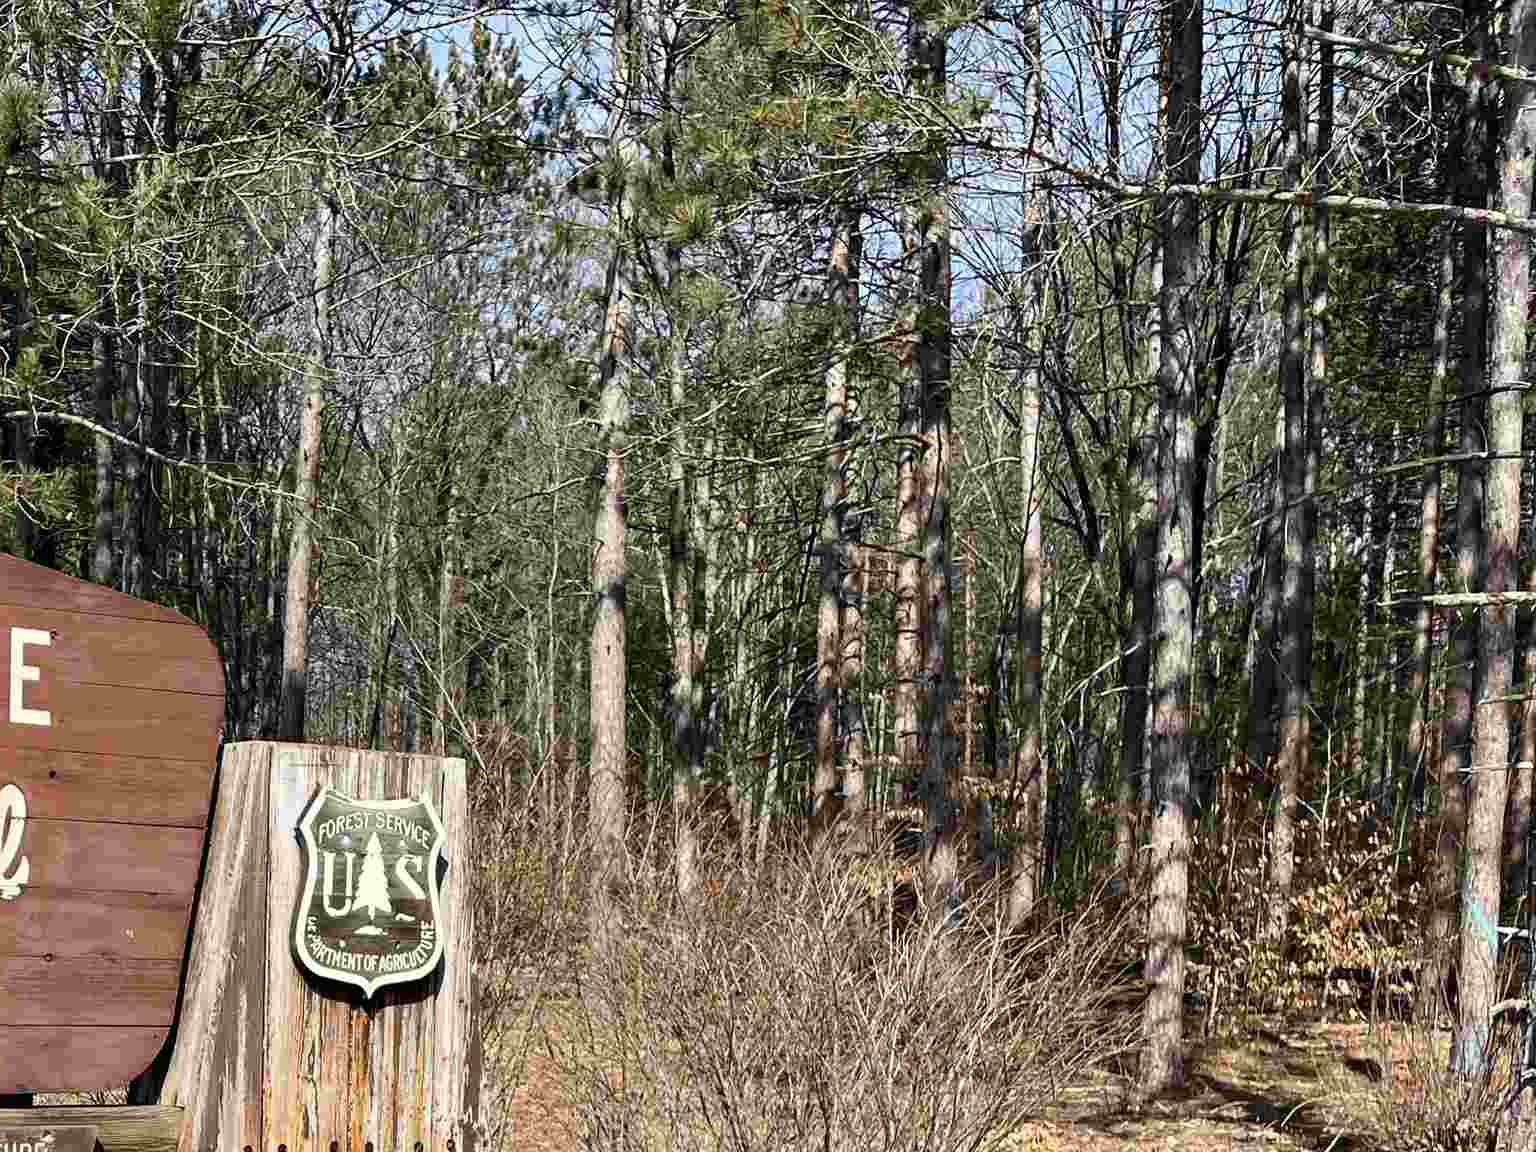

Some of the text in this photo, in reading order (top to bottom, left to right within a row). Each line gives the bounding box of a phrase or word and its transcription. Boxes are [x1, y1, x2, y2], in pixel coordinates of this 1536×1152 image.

[318, 810, 432, 850] FOREST SERVICE
[363, 953, 378, 972] OF
[378, 919, 437, 972] AGRICULTURE
